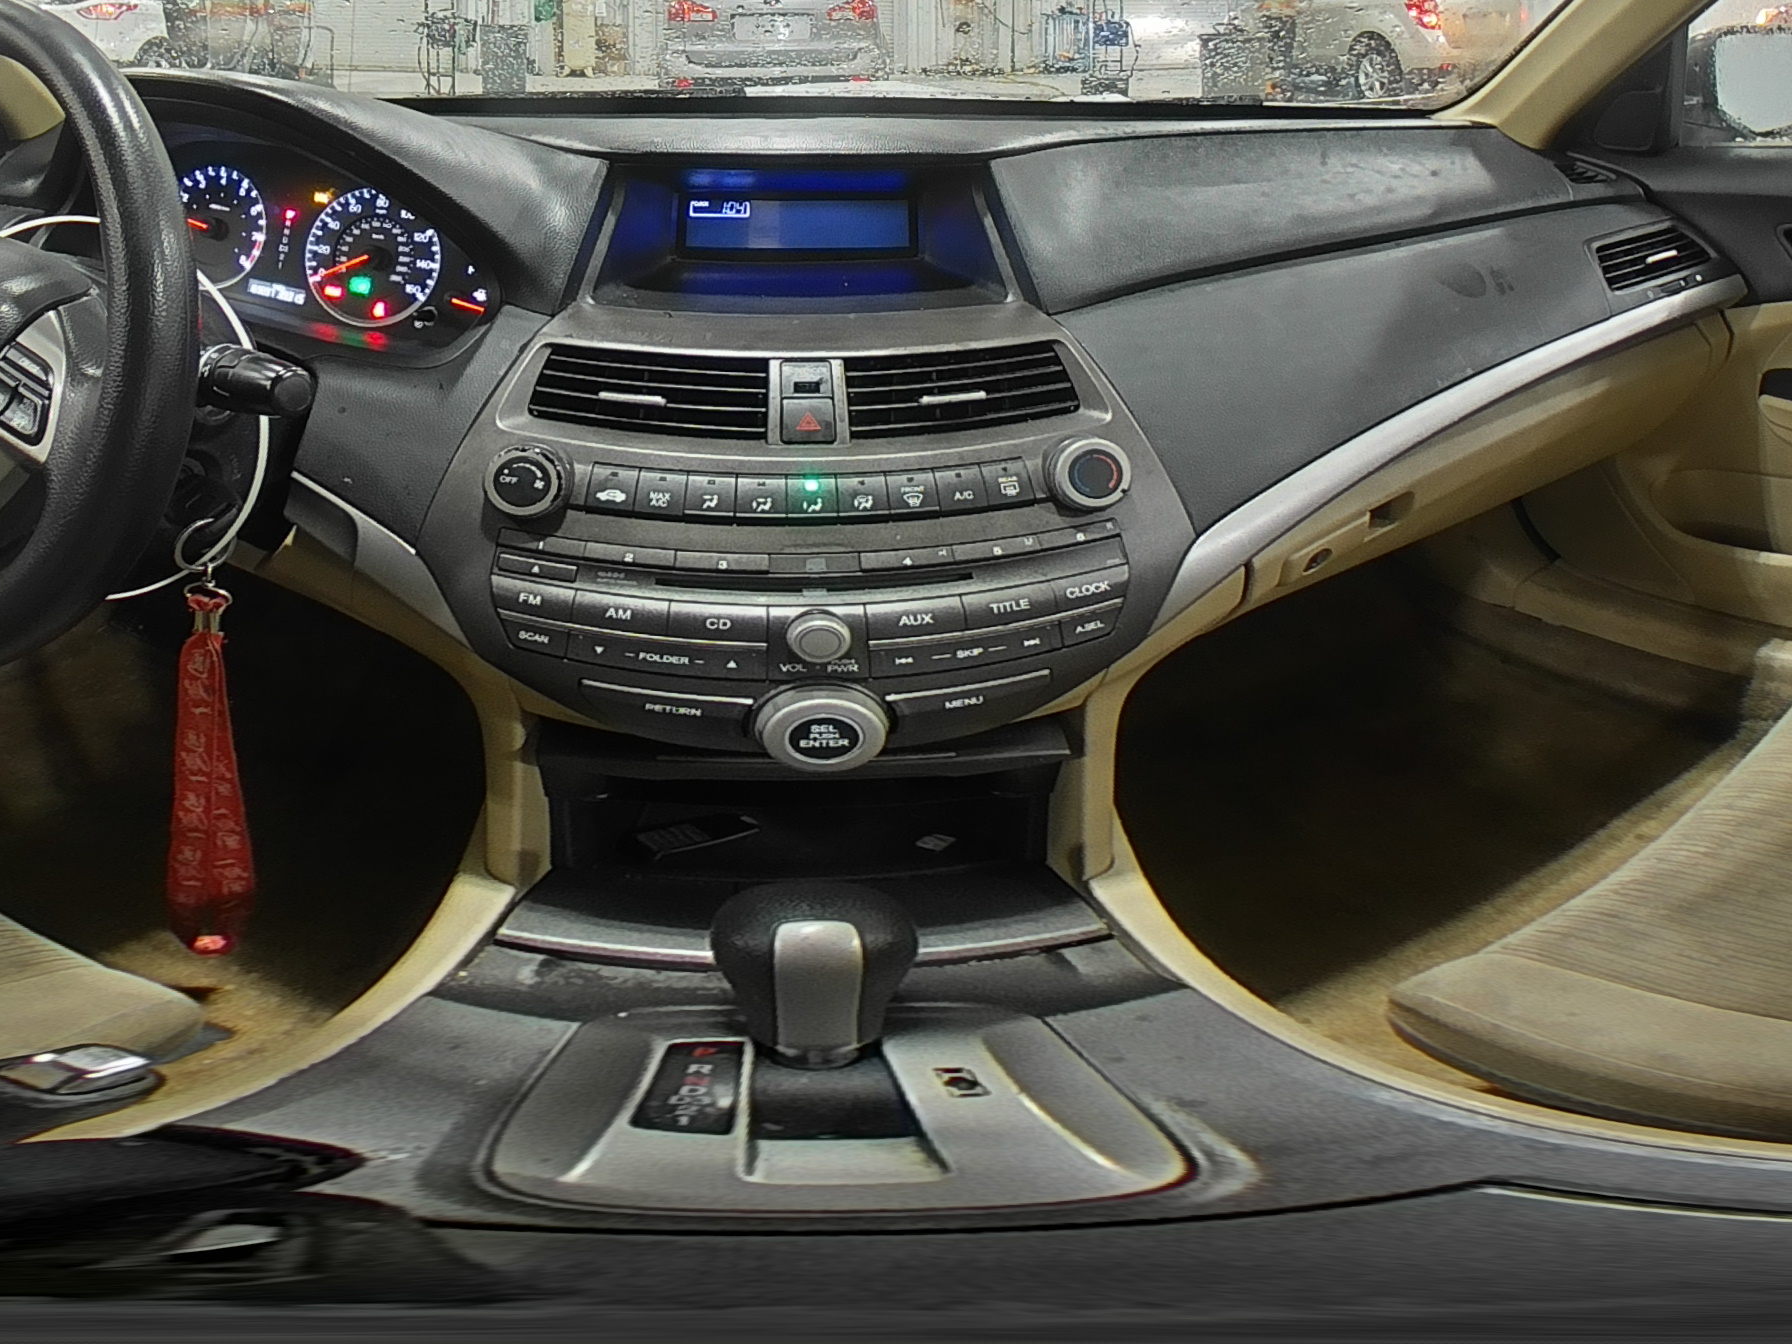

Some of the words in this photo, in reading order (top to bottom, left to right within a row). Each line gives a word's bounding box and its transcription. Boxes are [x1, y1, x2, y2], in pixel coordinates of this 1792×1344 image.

[499, 474, 519, 486] OFF
[648, 491, 672, 501] MAX
[954, 490, 975, 502] A/C
[1065, 580, 1113, 600] CLOCK
[517, 592, 543, 607] FM
[604, 606, 633, 621] AM
[989, 599, 1032, 615] TITLE
[705, 617, 732, 631] CD
[898, 612, 935, 627] AUX
[517, 629, 551, 645] SCAN
[638, 651, 691, 666] FOLDER
[955, 646, 985, 659] SKIP
[779, 662, 808, 674] VOL
[826, 663, 860, 674] PWR
[944, 694, 985, 711] MENU
[644, 702, 702, 717] RETURN
[810, 724, 839, 734] SEL
[798, 738, 851, 749] ENTER
[685, 1063, 714, 1074] R
[678, 1085, 707, 1096] D
